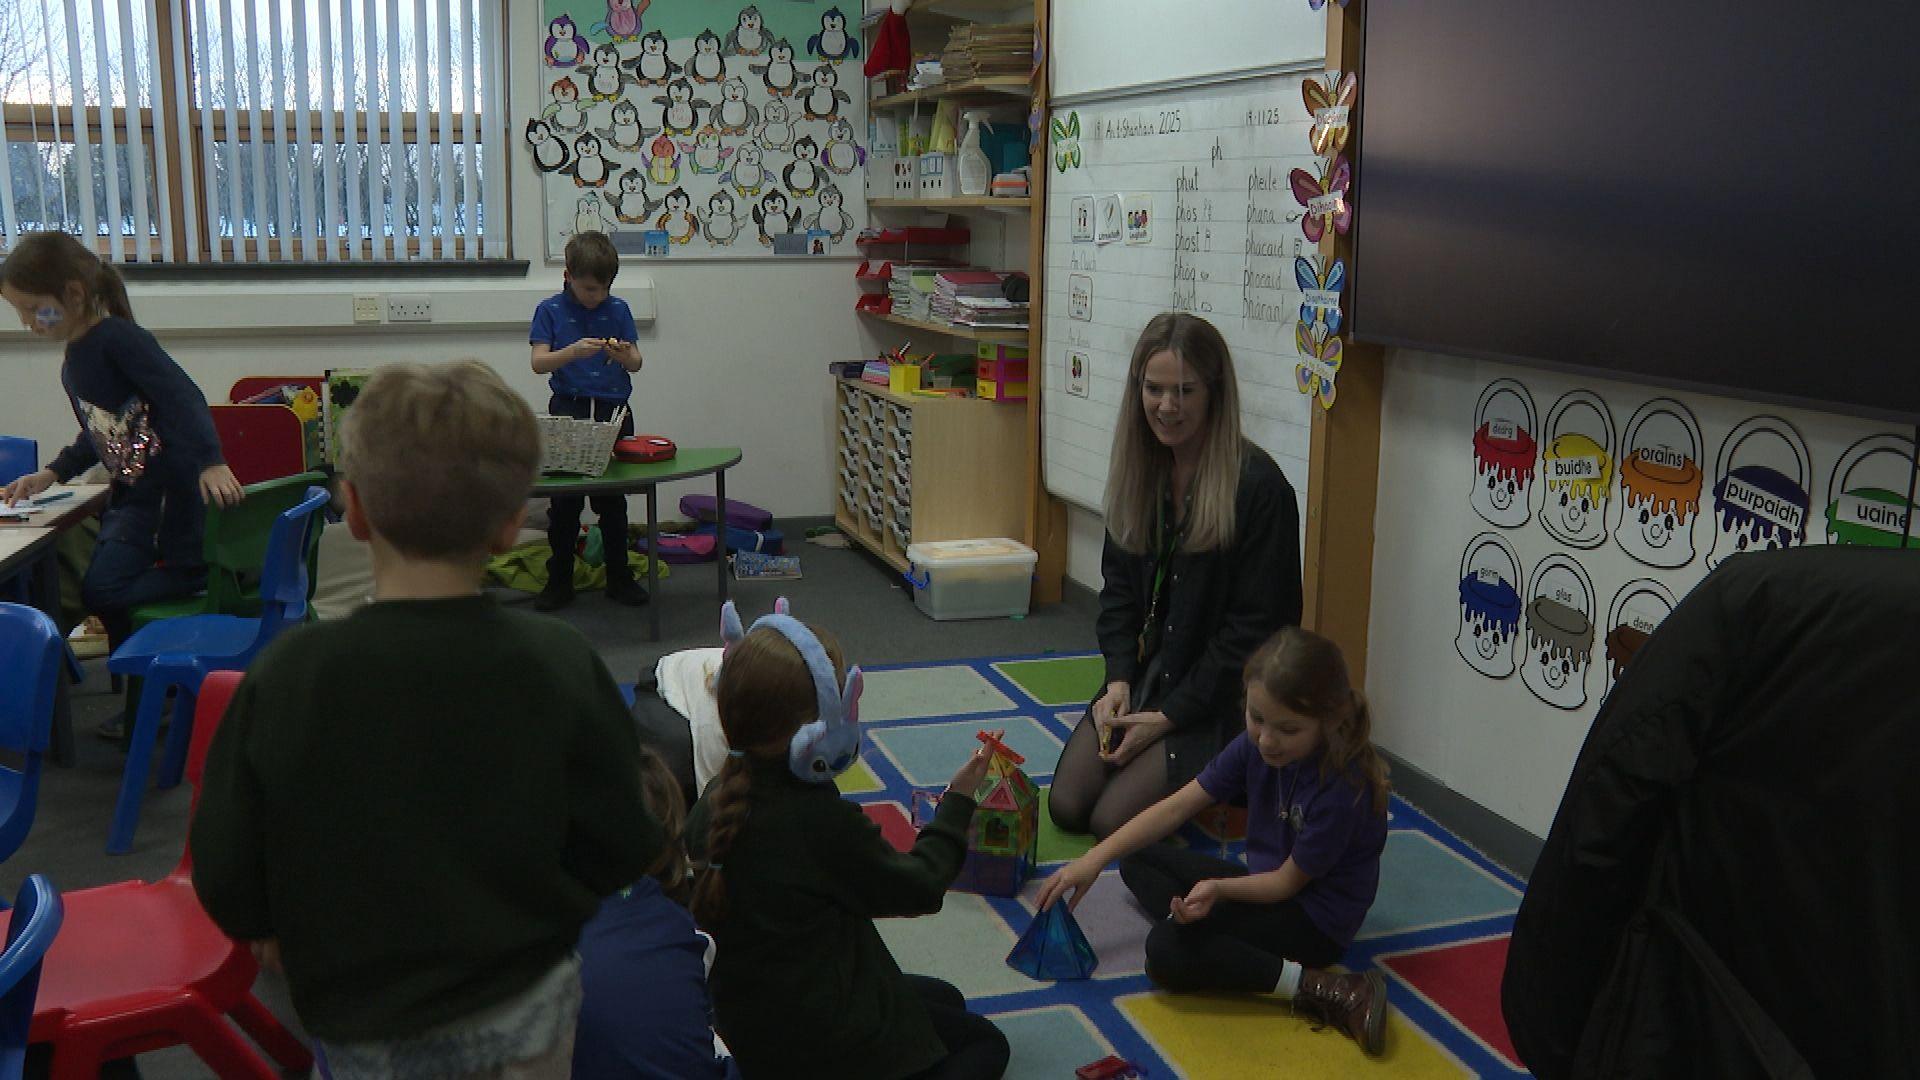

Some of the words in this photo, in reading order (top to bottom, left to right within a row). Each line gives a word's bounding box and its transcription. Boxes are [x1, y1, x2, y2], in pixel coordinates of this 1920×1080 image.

[1158, 109, 1182, 134] 2025
[1211, 135, 1223, 168] ph
[1555, 459, 1592, 475] buidhe
[1726, 481, 1800, 527] purpaidh
[1857, 504, 1907, 529] uaine
